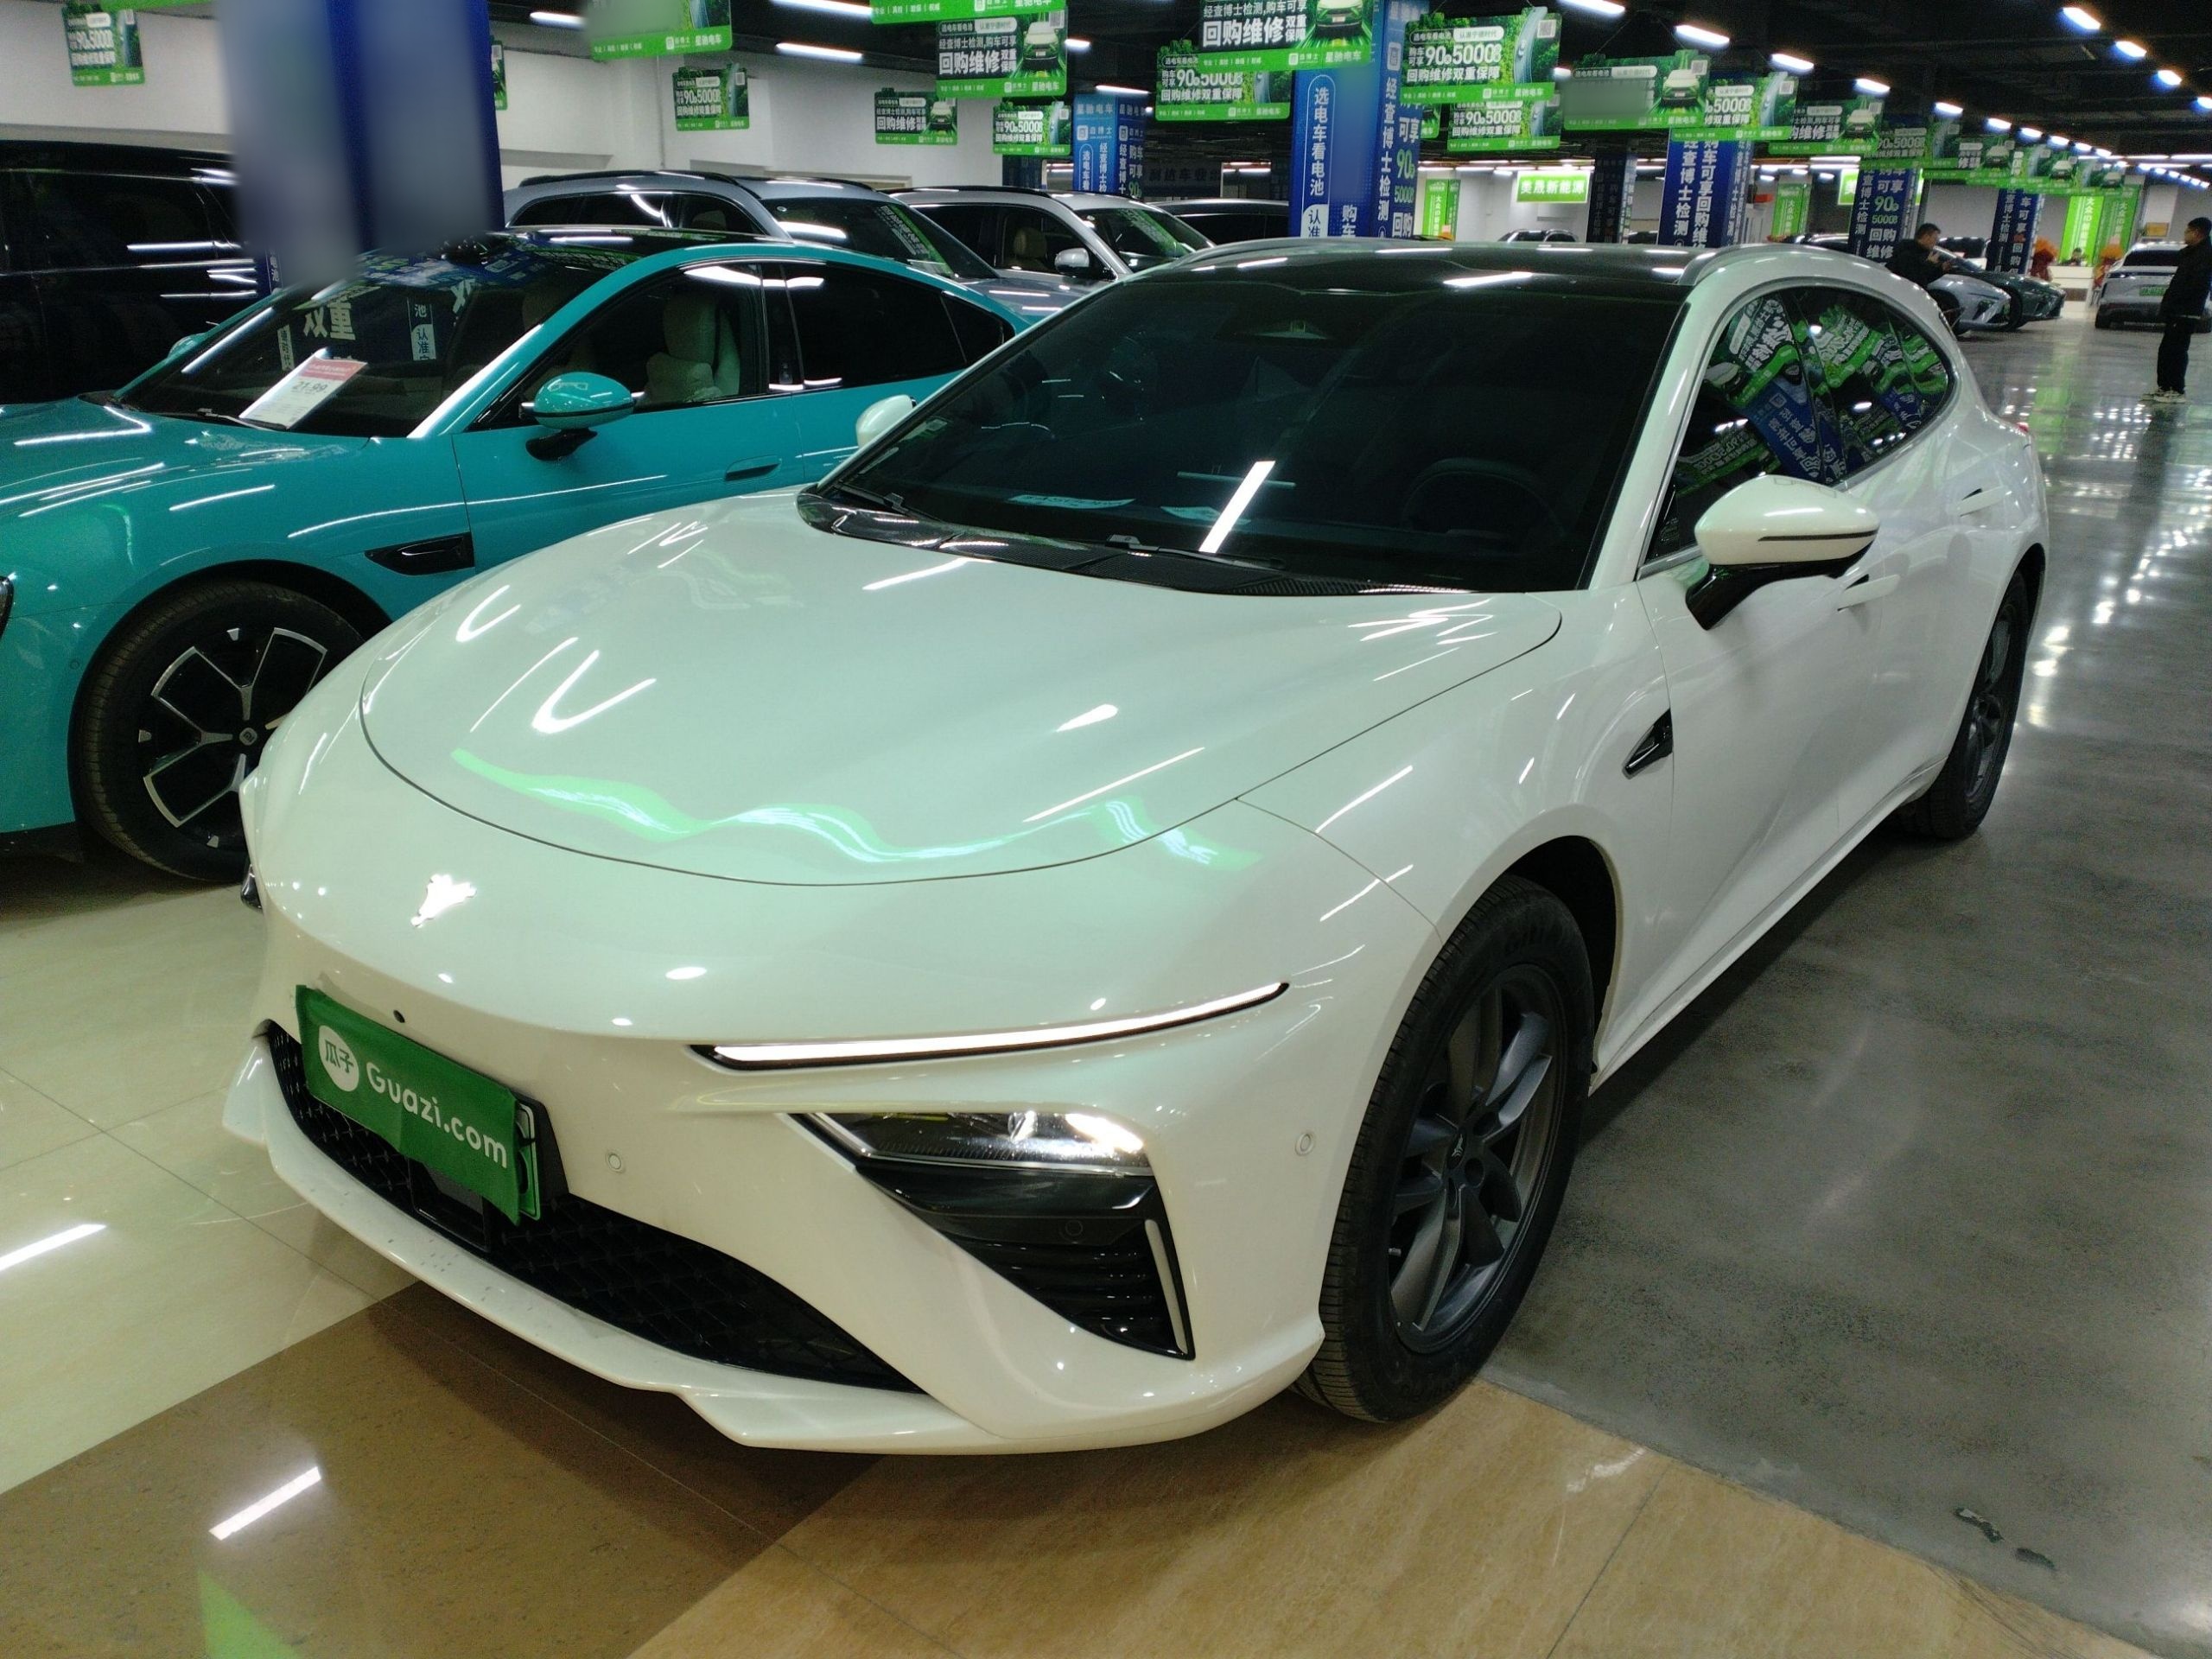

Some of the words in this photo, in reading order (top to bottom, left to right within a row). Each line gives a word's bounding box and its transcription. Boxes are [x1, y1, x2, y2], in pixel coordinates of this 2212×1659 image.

[1203, 16, 1284, 47] 回购维修
[1285, 15, 1306, 28] 双重
[939, 50, 1000, 74] 回购维修
[1407, 66, 1501, 83] 回购维修双重保障
[1161, 88, 1243, 102] 回购维修双重保障
[877, 116, 917, 131] 回购维修
[1399, 117, 1420, 143] 可享
[1310, 87, 1330, 196] 选电车看电池
[1378, 77, 1397, 221] 经查博士检测
[1392, 212, 1413, 238] 回购
[1869, 228, 1897, 242] 回购
[416, 327, 429, 360] 认准
[325, 1039, 354, 1073] 瓜子
[366, 1062, 507, 1168] Guazi.com
